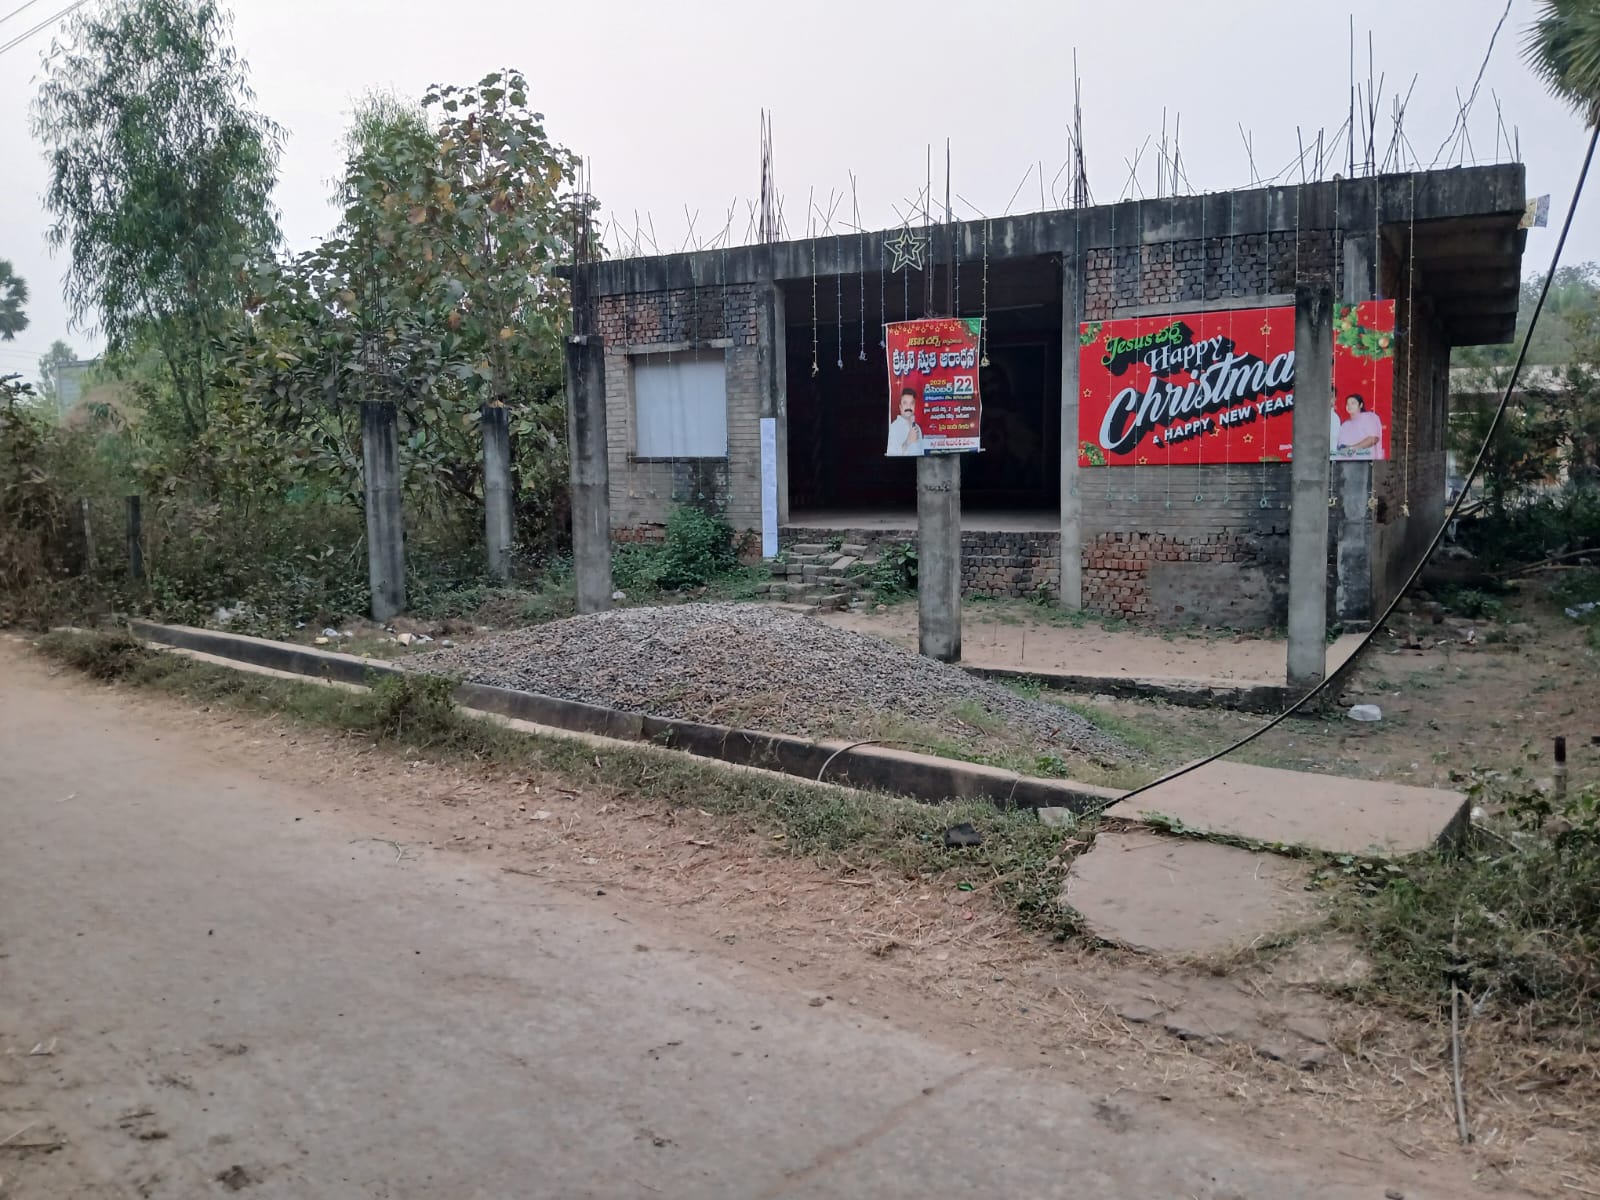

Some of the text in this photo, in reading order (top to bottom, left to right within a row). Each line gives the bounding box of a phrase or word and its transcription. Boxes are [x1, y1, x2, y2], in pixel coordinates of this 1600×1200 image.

[939, 347, 975, 368] ఆరాధన
[1101, 333, 1153, 365] Jesus
[1143, 334, 1223, 373] Happy
[956, 377, 973, 392] 22
[1098, 350, 1295, 450] Christma
[1152, 394, 1294, 444] & HAPPY NEW YEAR
